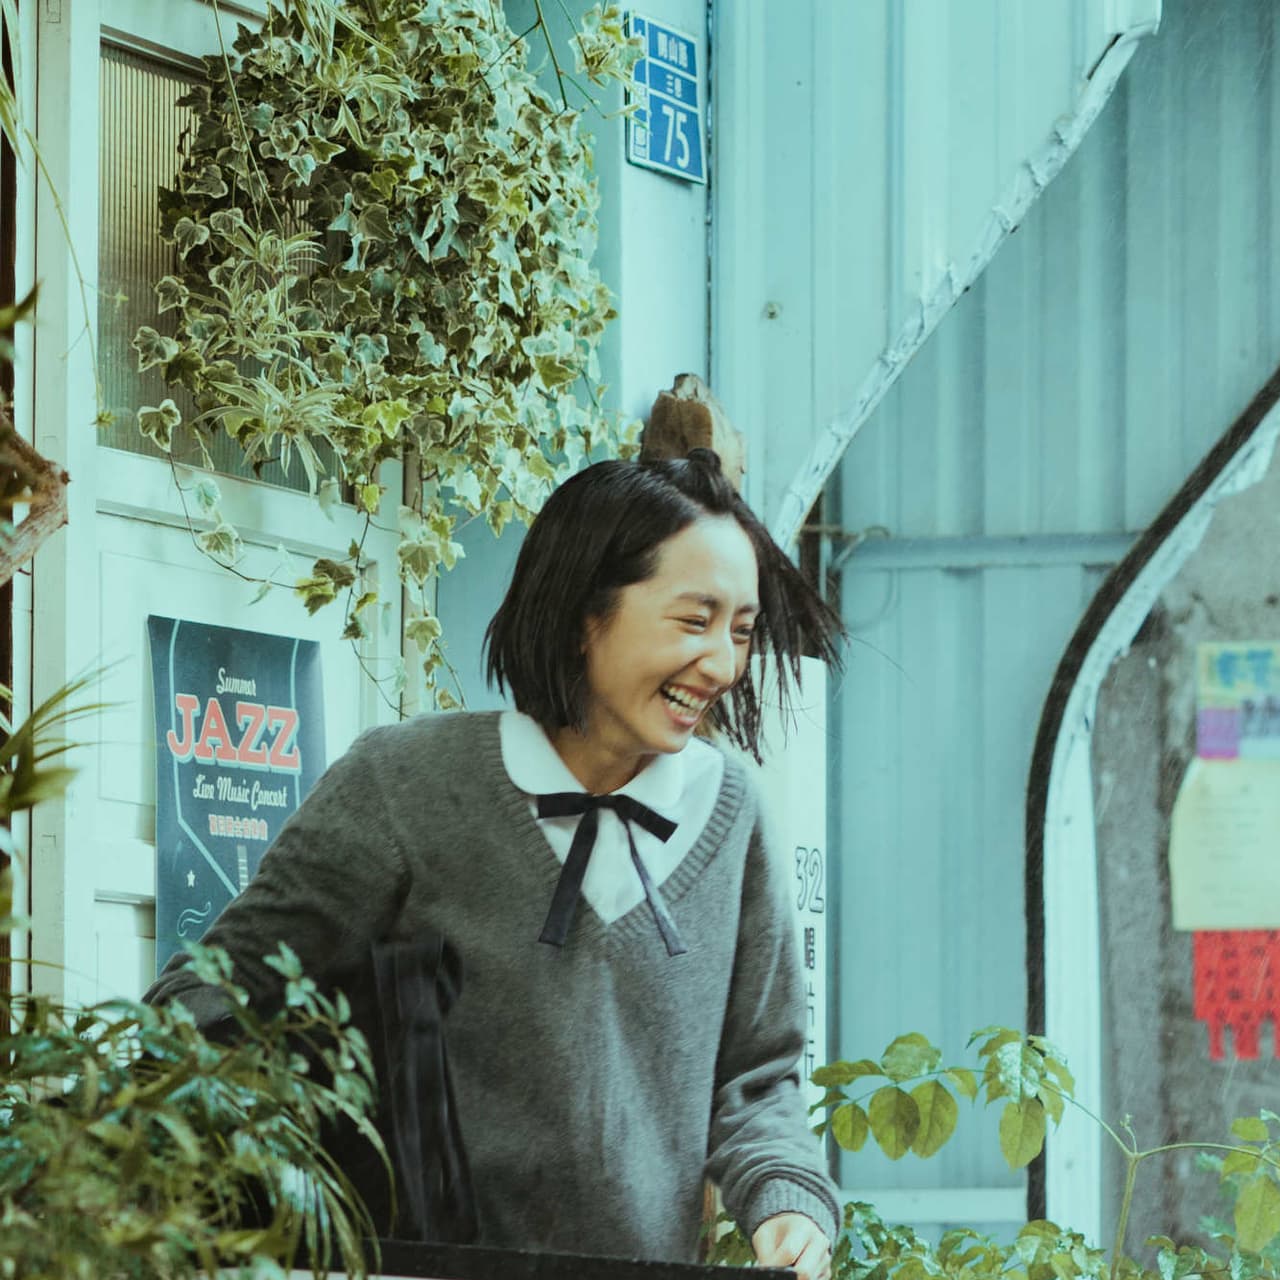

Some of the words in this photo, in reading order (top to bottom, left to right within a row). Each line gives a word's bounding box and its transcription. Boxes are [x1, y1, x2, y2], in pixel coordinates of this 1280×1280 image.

[662, 104, 690, 169] 75
[216, 667, 257, 697] Summer
[167, 693, 302, 774] JAZZ
[193, 774, 215, 800] Live
[217, 776, 250, 803] Music
[251, 780, 288, 811] Concert
[795, 846, 824, 913] 32
